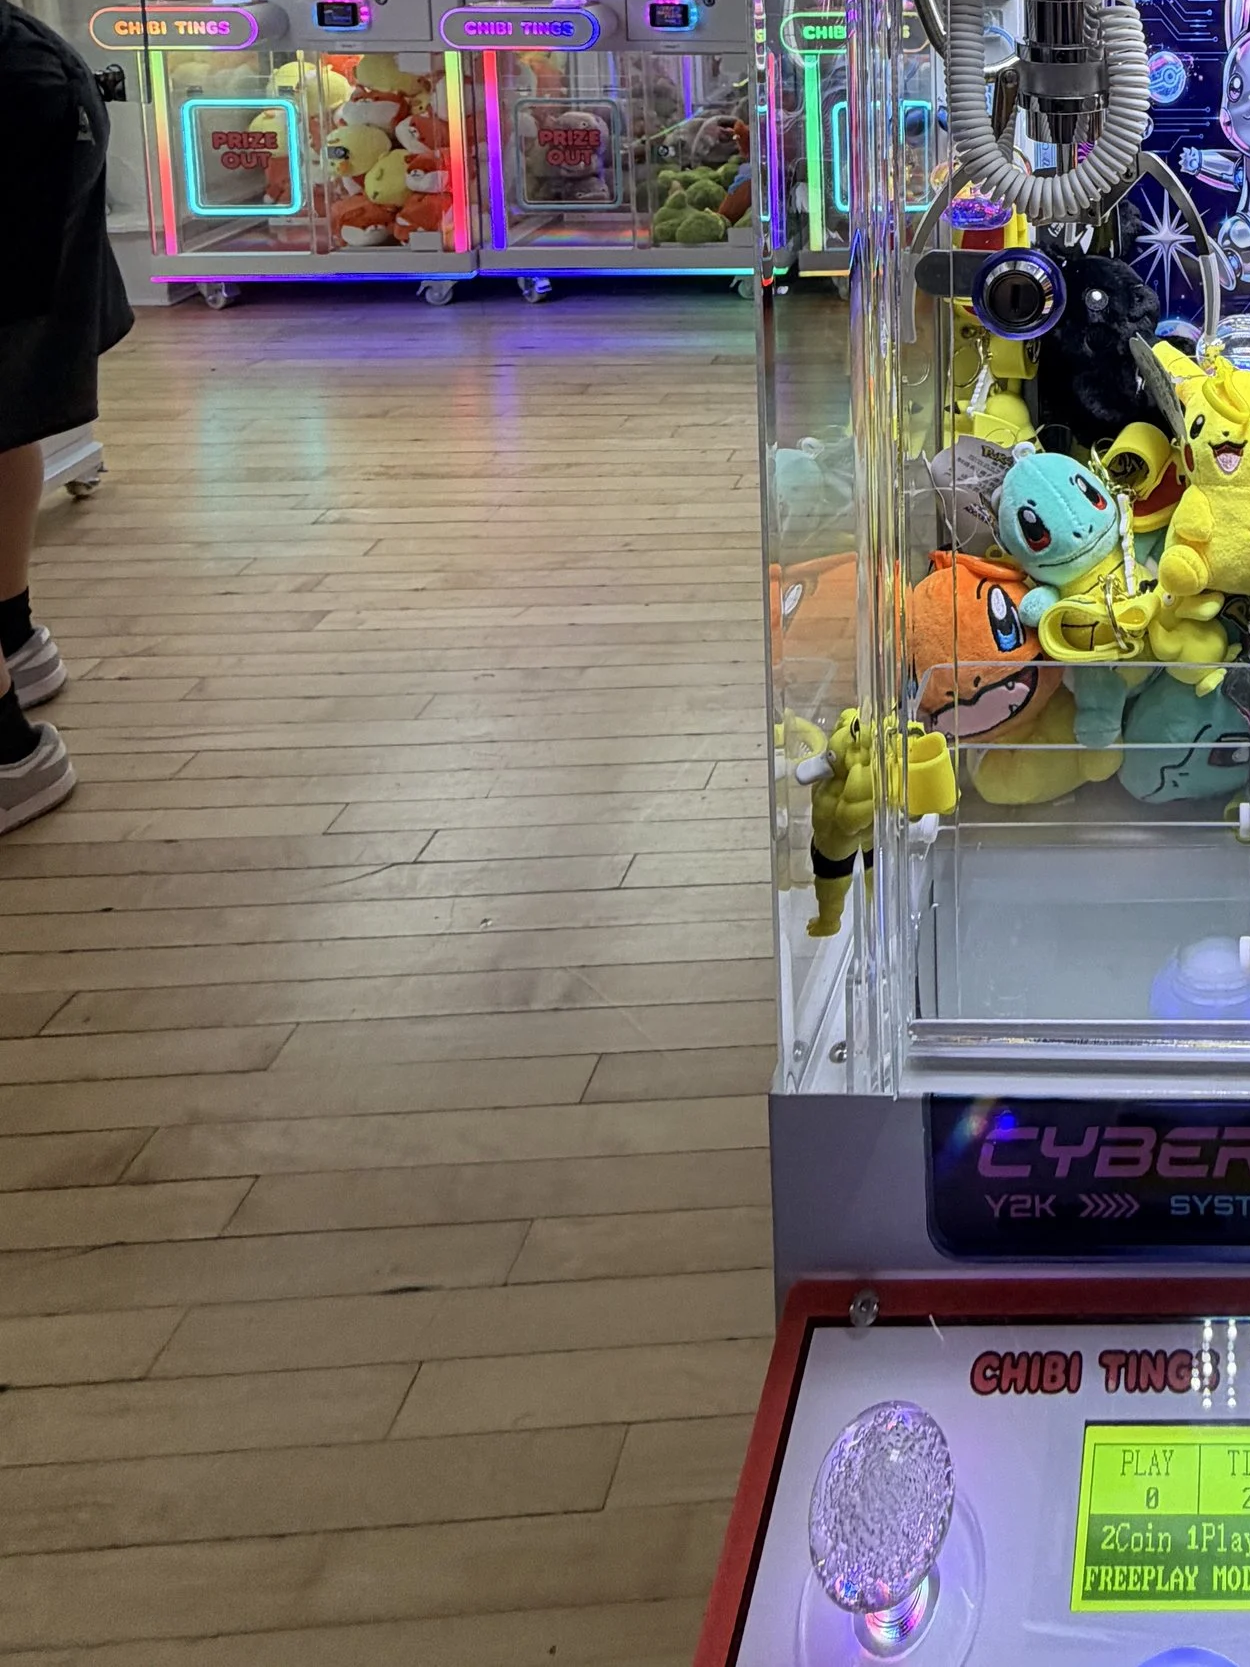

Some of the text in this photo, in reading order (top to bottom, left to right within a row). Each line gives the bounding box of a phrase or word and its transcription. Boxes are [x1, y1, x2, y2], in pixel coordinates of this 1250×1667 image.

[174, 20, 230, 35] TINGS
[463, 20, 574, 36] CHIBI TINGS
[211, 131, 278, 150] PRIZE
[538, 129, 601, 147] PRIZE
[221, 151, 272, 170] OUT
[546, 148, 593, 166] OUT
[984, 1194, 1057, 1218] Y2K
[970, 1350, 1083, 1395] CHIBI
[1120, 1449, 1175, 1476] PLAY
[1145, 1487, 1159, 1509] 0
[1101, 1522, 1172, 1552] 2Coin
[1084, 1565, 1199, 1592] FREEPLAY
